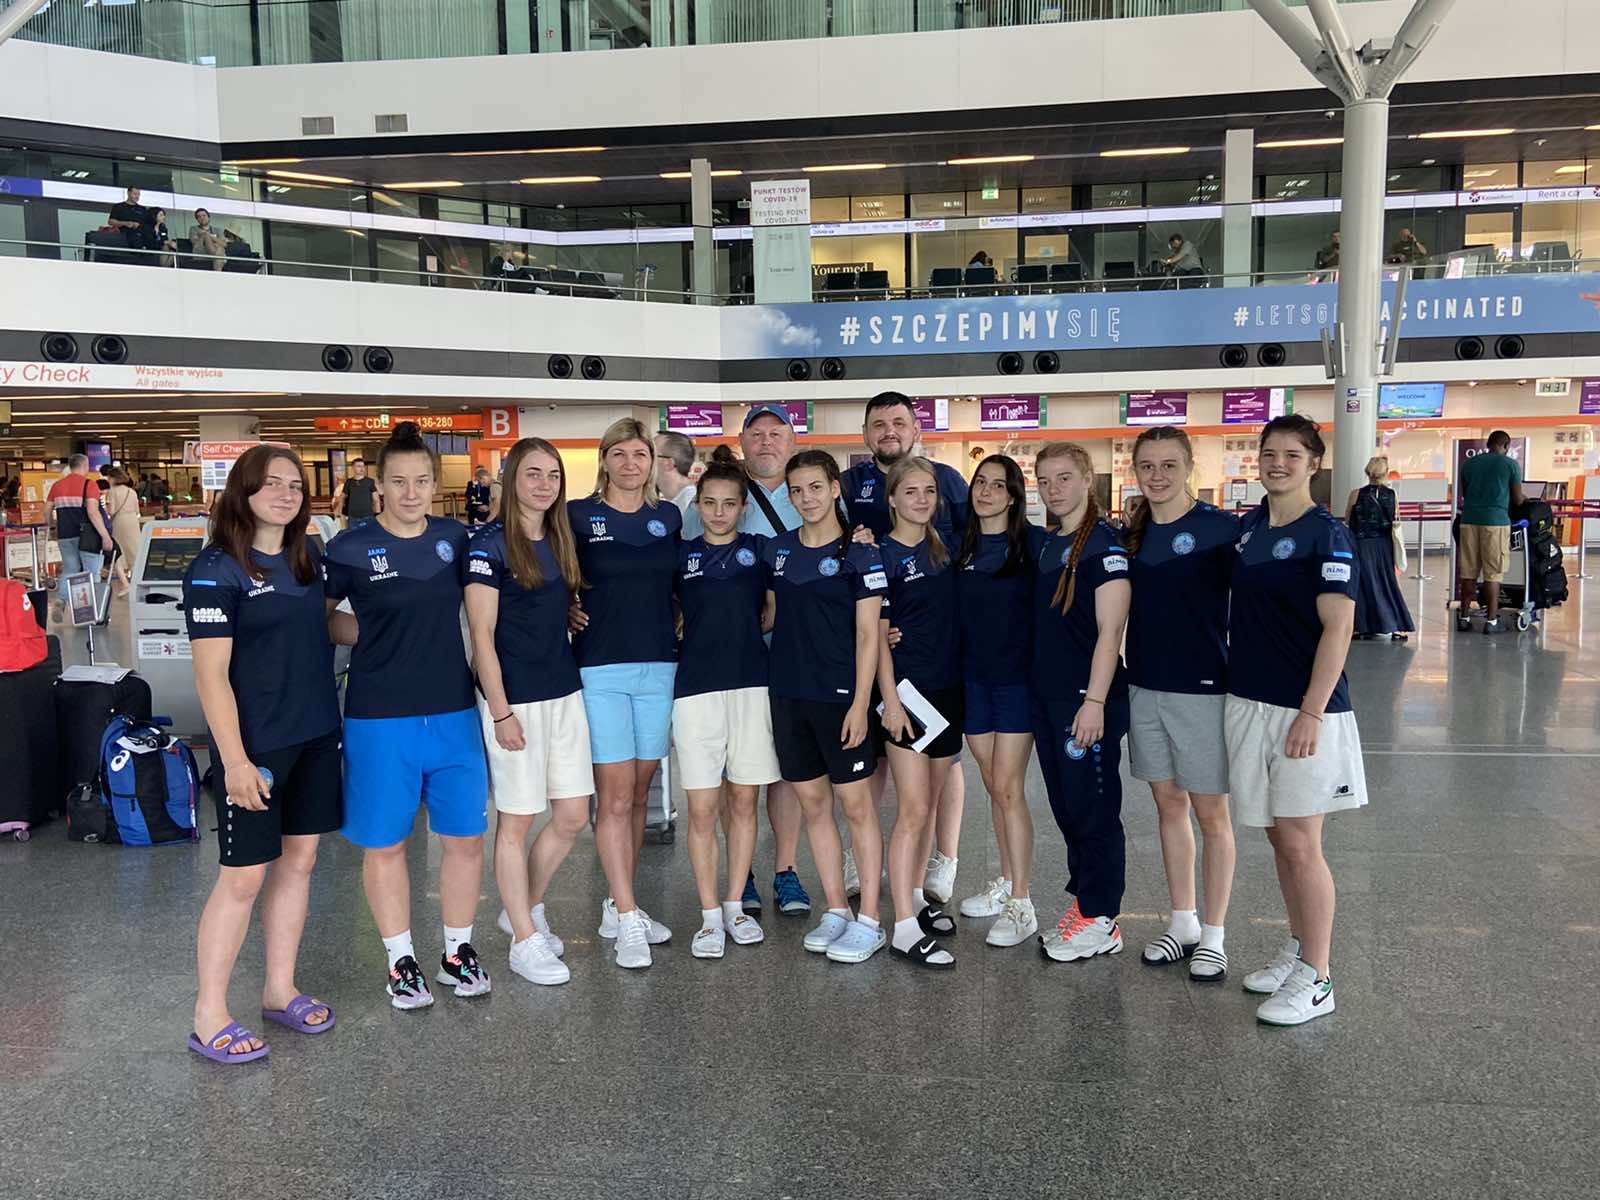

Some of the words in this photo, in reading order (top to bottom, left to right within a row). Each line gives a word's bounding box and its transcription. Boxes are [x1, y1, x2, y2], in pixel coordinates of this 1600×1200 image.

[1538, 190, 1560, 198] Rent
[786, 208, 807, 216] POINT
[812, 264, 840, 276] Your
[0, 367, 15, 384] y
[22, 364, 90, 382] Check
[135, 366, 185, 377] Wszystkie
[136, 379, 149, 387] All
[151, 380, 180, 389] gates
[491, 409, 510, 436] B
[203, 444, 220, 454] Self
[369, 570, 399, 582] UKRAINE
[248, 584, 276, 598] UKRAINE
